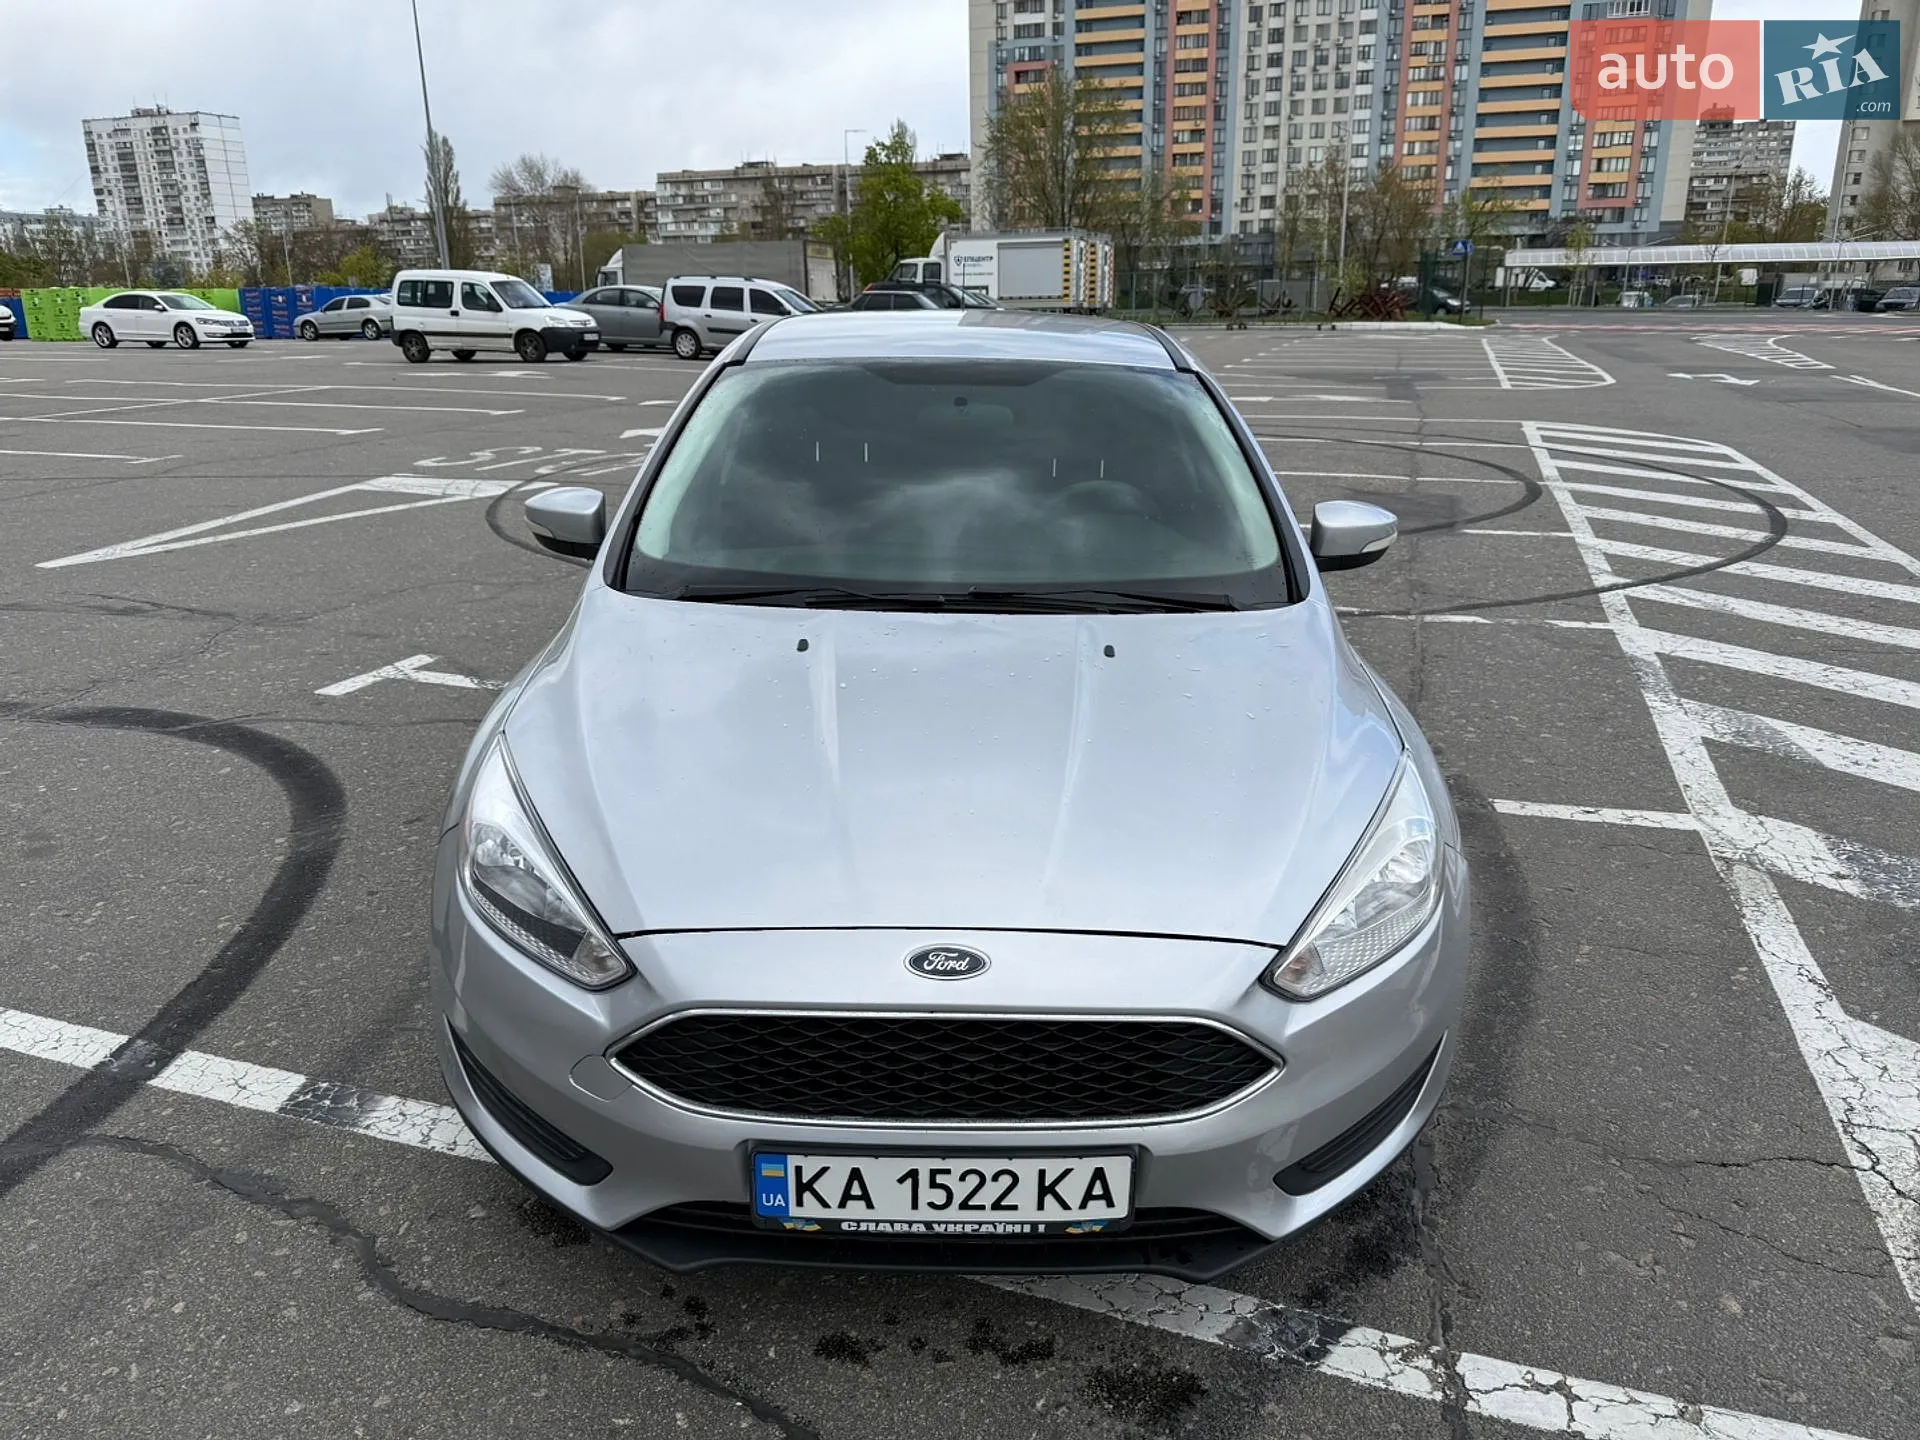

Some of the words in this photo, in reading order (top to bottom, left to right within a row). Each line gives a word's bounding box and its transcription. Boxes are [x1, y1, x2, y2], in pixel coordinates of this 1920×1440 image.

[923, 951, 970, 971] Ford
[794, 1165, 875, 1210] KA
[895, 1167, 1020, 1211] 1522
[1036, 1166, 1116, 1212] KA
[762, 1193, 786, 1207] UA
[840, 1221, 928, 1233] СЛАВА
[931, 1222, 1031, 1234] УКРАЇНІ
